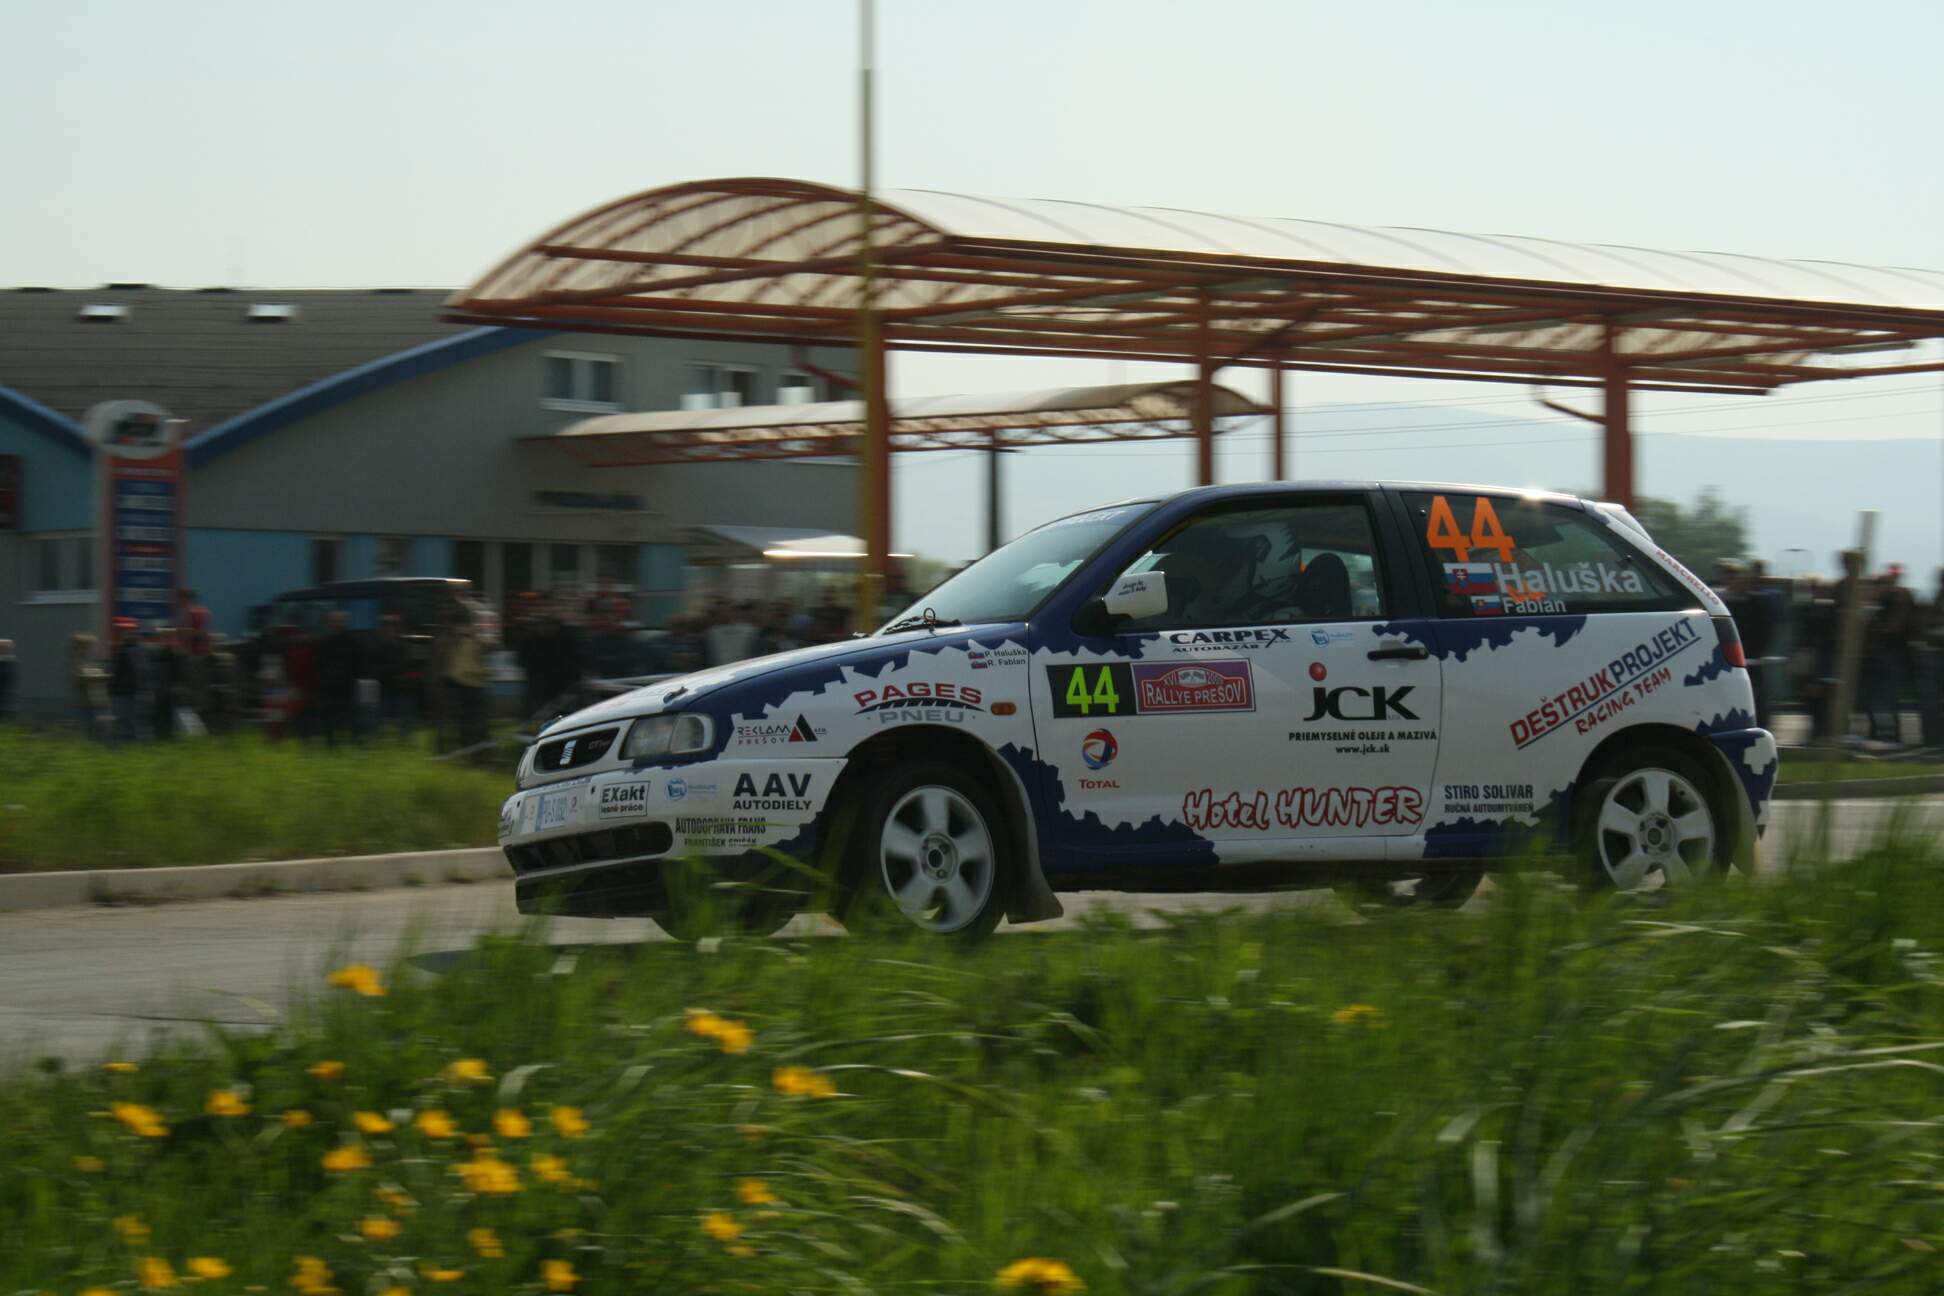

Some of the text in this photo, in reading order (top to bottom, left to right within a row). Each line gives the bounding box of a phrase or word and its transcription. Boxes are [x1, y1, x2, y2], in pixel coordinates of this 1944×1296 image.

[1426, 496, 1516, 563] 44
[1496, 561, 1643, 593] Haluška
[1503, 598, 1566, 615] Fabian
[1170, 628, 1291, 649] CARPEX
[854, 682, 983, 707] PAGES
[1066, 665, 1120, 714] 44
[1146, 683, 1191, 705] RALLYE
[1575, 667, 1672, 736] RACING TEAM
[879, 709, 965, 724] PNEU
[1288, 728, 1437, 741] PRIEMYSELNÉ OLEJE A MAZIVÁ
[1335, 743, 1390, 756] www.jck.sk
[602, 784, 645, 803] EXakt
[733, 773, 812, 797] AAV
[1078, 778, 1120, 789] TOTAL
[1444, 785, 1534, 799] STIRO SOLIVAR
[733, 800, 812, 810] AUTODIELY
[1183, 786, 1422, 830] Hotel HUNTER
